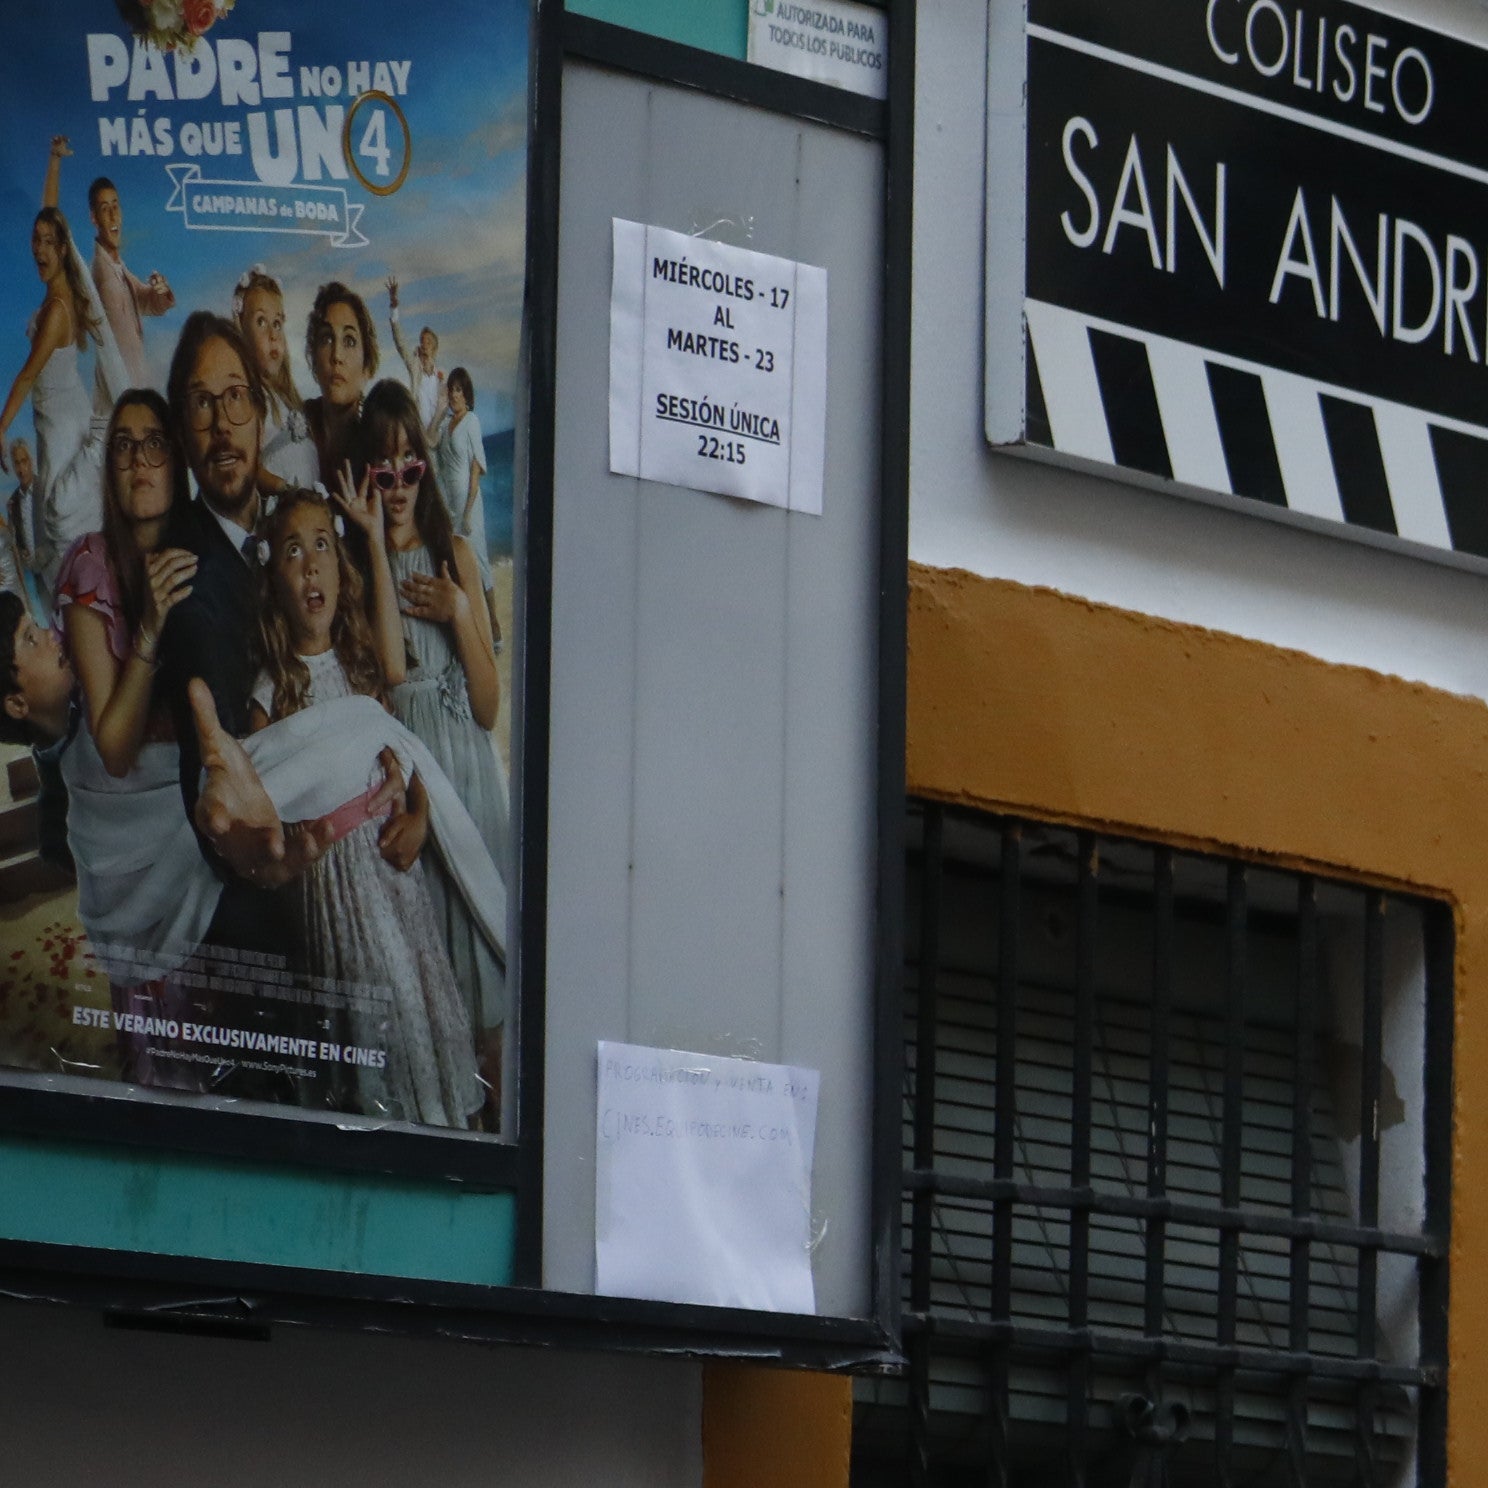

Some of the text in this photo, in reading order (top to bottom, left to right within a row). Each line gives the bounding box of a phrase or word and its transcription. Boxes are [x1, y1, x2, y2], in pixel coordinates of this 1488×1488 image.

[769, 24, 805, 50] TODOS
[807, 34, 828, 56] LOS
[777, 3, 875, 44] AUTORIZADA PARA
[86, 31, 412, 106] PADRE NO HAY
[1206, 0, 1433, 125] COLISEO
[98, 108, 173, 156] MÁS
[179, 121, 242, 155] QUE
[359, 109, 390, 176] 4
[192, 194, 339, 222] CAMPANAS de BODA
[1060, 116, 1226, 291] SAN
[652, 256, 755, 302] MIÉRCOLES
[770, 286, 790, 310] 17
[713, 305, 735, 330] AL
[667, 327, 740, 364] MARTES
[755, 348, 775, 373] 23
[656, 392, 781, 443] SESIÓN ÚNICA
[697, 434, 746, 465] 22:15
[72, 1006, 386, 1069] ESTE VERANO EXCLUSIVAMENTE EN CINES
